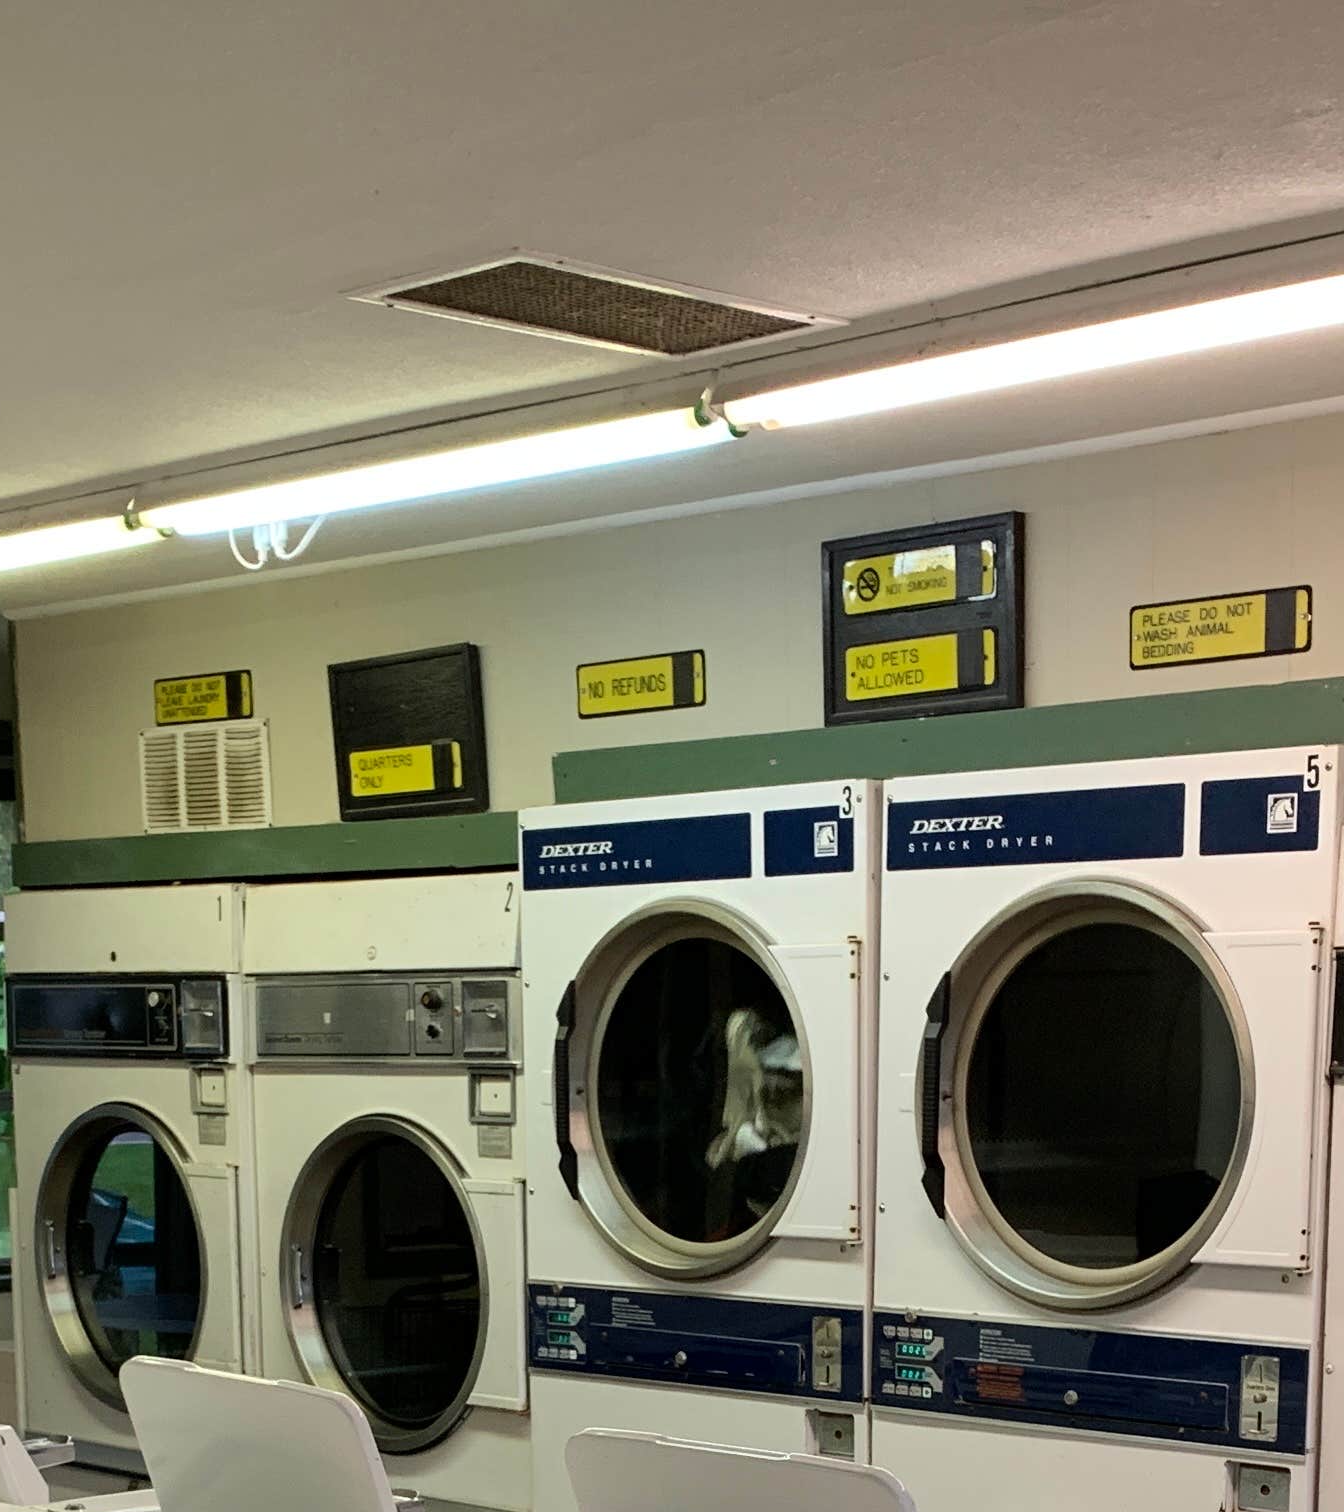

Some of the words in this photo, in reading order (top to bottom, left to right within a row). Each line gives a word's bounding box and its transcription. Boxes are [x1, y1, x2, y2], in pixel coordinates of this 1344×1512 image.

[1142, 610, 1191, 627] PLEASE
[1199, 606, 1218, 621] DO
[1226, 602, 1253, 618] NOT
[1142, 627, 1178, 643] WASH
[1186, 622, 1235, 638] ANIMAL
[856, 653, 875, 670] NO
[881, 648, 920, 668] PETS
[1142, 642, 1194, 660] BEDDING
[588, 680, 605, 700] NO
[611, 673, 667, 697] REFUNDS
[857, 669, 925, 691] ALLOWED
[358, 753, 413, 771] QUARTERS
[1306, 754, 1321, 789] 5
[359, 775, 384, 790] ONLY
[842, 785, 853, 816] 3
[909, 814, 1005, 835] DEXTER
[539, 841, 614, 859] DEXTER
[908, 839, 972, 854] STACK
[986, 834, 1055, 850] DRYER
[538, 862, 590, 875] STACK
[599, 858, 654, 872] DRYER
[504, 881, 515, 913] 2
[217, 895, 223, 922] 1
